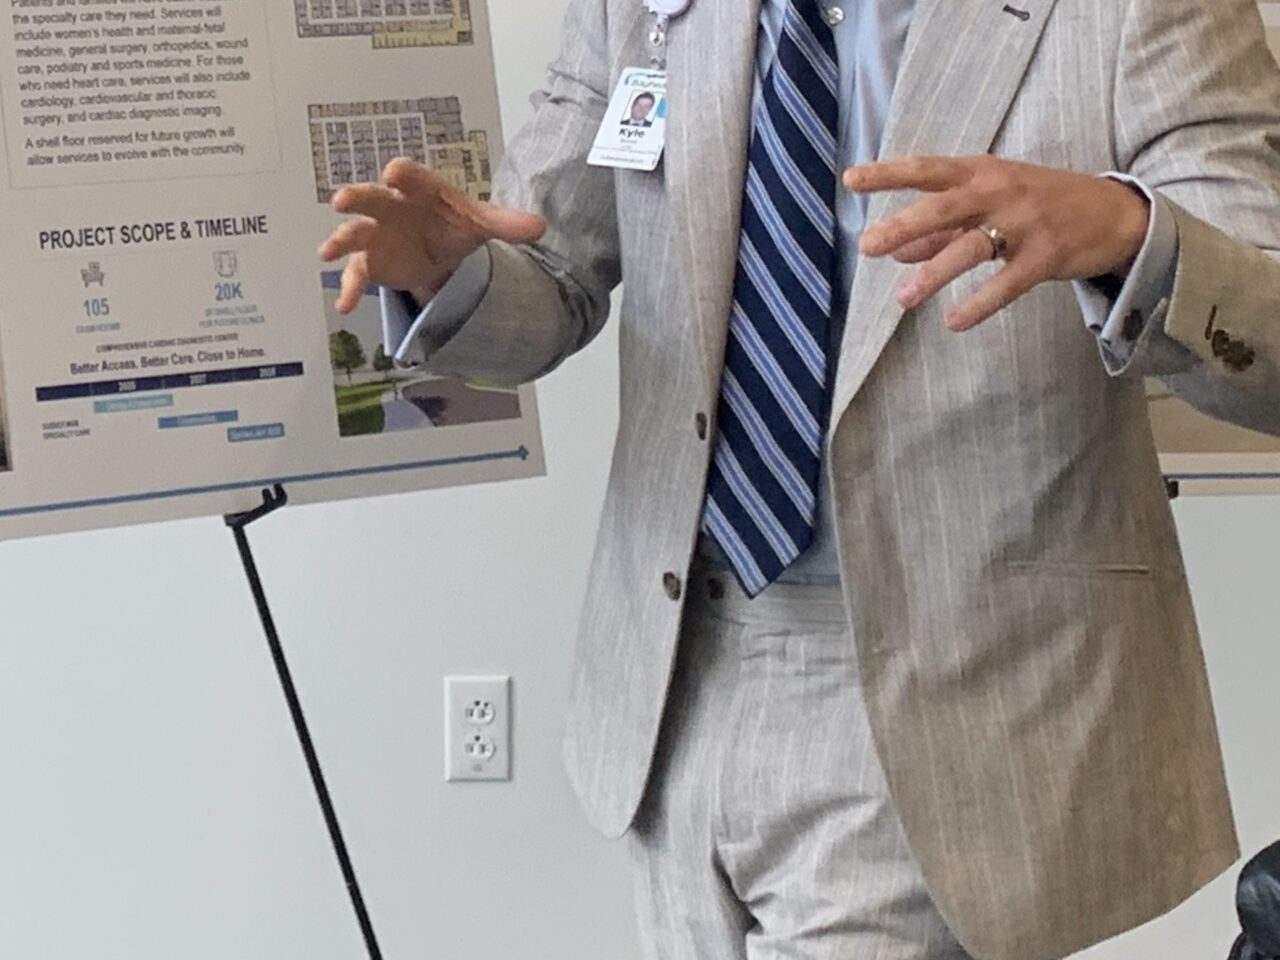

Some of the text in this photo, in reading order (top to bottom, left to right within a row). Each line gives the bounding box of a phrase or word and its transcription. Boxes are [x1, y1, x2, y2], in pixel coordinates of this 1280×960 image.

[619, 128, 645, 137] Kyle
[40, 215, 268, 249] PROJECT SCOPE & TIMELINE
[215, 282, 243, 301] 20K
[84, 298, 109, 316] 105
[70, 363, 99, 375] Better
[141, 357, 168, 368] Better
[197, 351, 223, 362] Close
[226, 350, 235, 359] to
